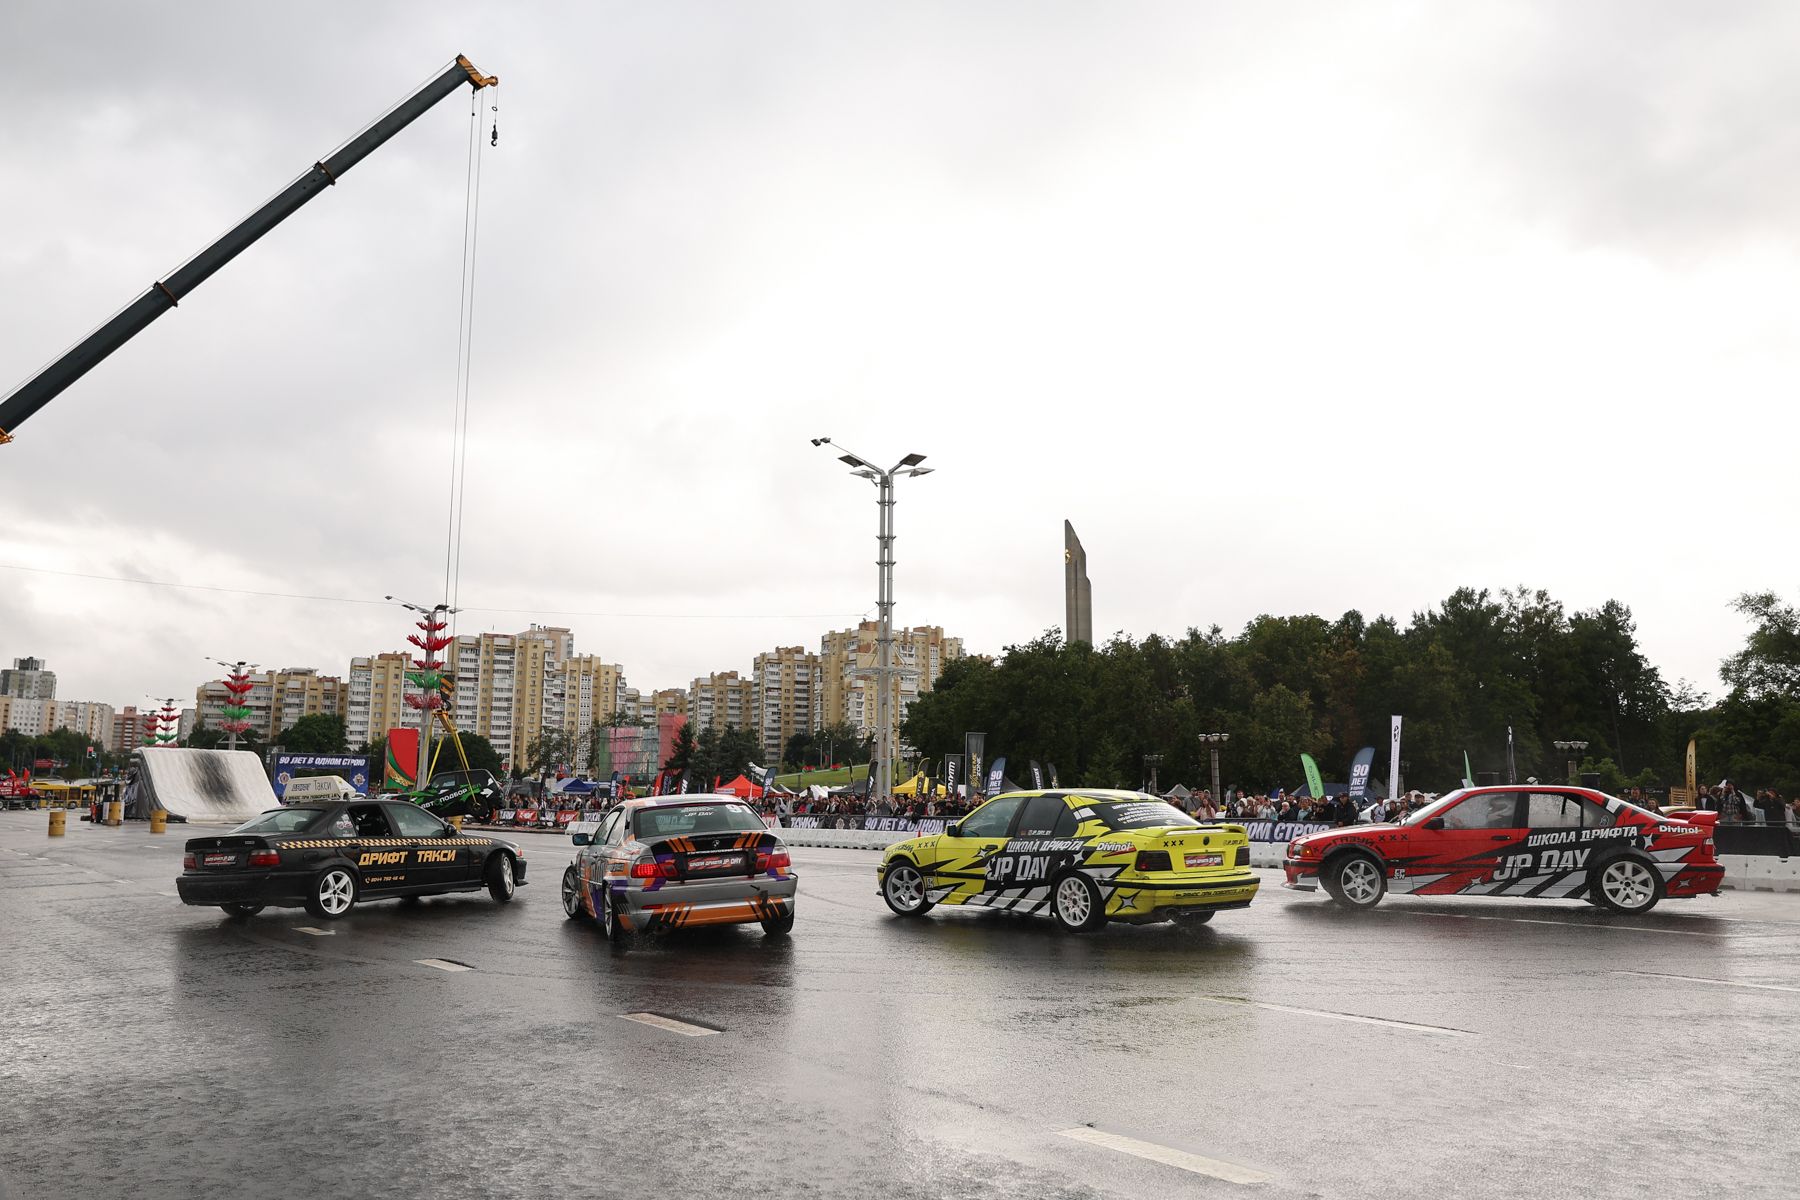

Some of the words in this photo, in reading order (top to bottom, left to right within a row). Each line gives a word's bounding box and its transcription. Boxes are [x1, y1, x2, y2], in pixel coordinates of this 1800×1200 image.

[279, 756, 290, 765] 90
[290, 756, 307, 765] ЛЕТ
[307, 757, 314, 765] В
[315, 757, 341, 766] ОДНОМ
[342, 758, 366, 767] СТРОЮ
[990, 770, 1002, 780] 90
[1352, 764, 1369, 777] 90
[1351, 777, 1368, 786] ЛЕТ
[864, 817, 878, 831] 90
[877, 818, 898, 831] ЛЕТ
[897, 819, 908, 832] В
[1659, 825, 1699, 834] Divinol
[1527, 830, 1576, 847] ШКОЛА
[1580, 826, 1638, 842] ДРИФТА
[1006, 840, 1040, 853] ШКОЛА
[1039, 838, 1085, 852] ДРИФТА
[1096, 841, 1131, 851] Divinol
[358, 851, 408, 866] ДРИФТ
[416, 849, 457, 863] ТАКСИ
[986, 856, 1014, 881] JP
[1493, 853, 1534, 881] JP
